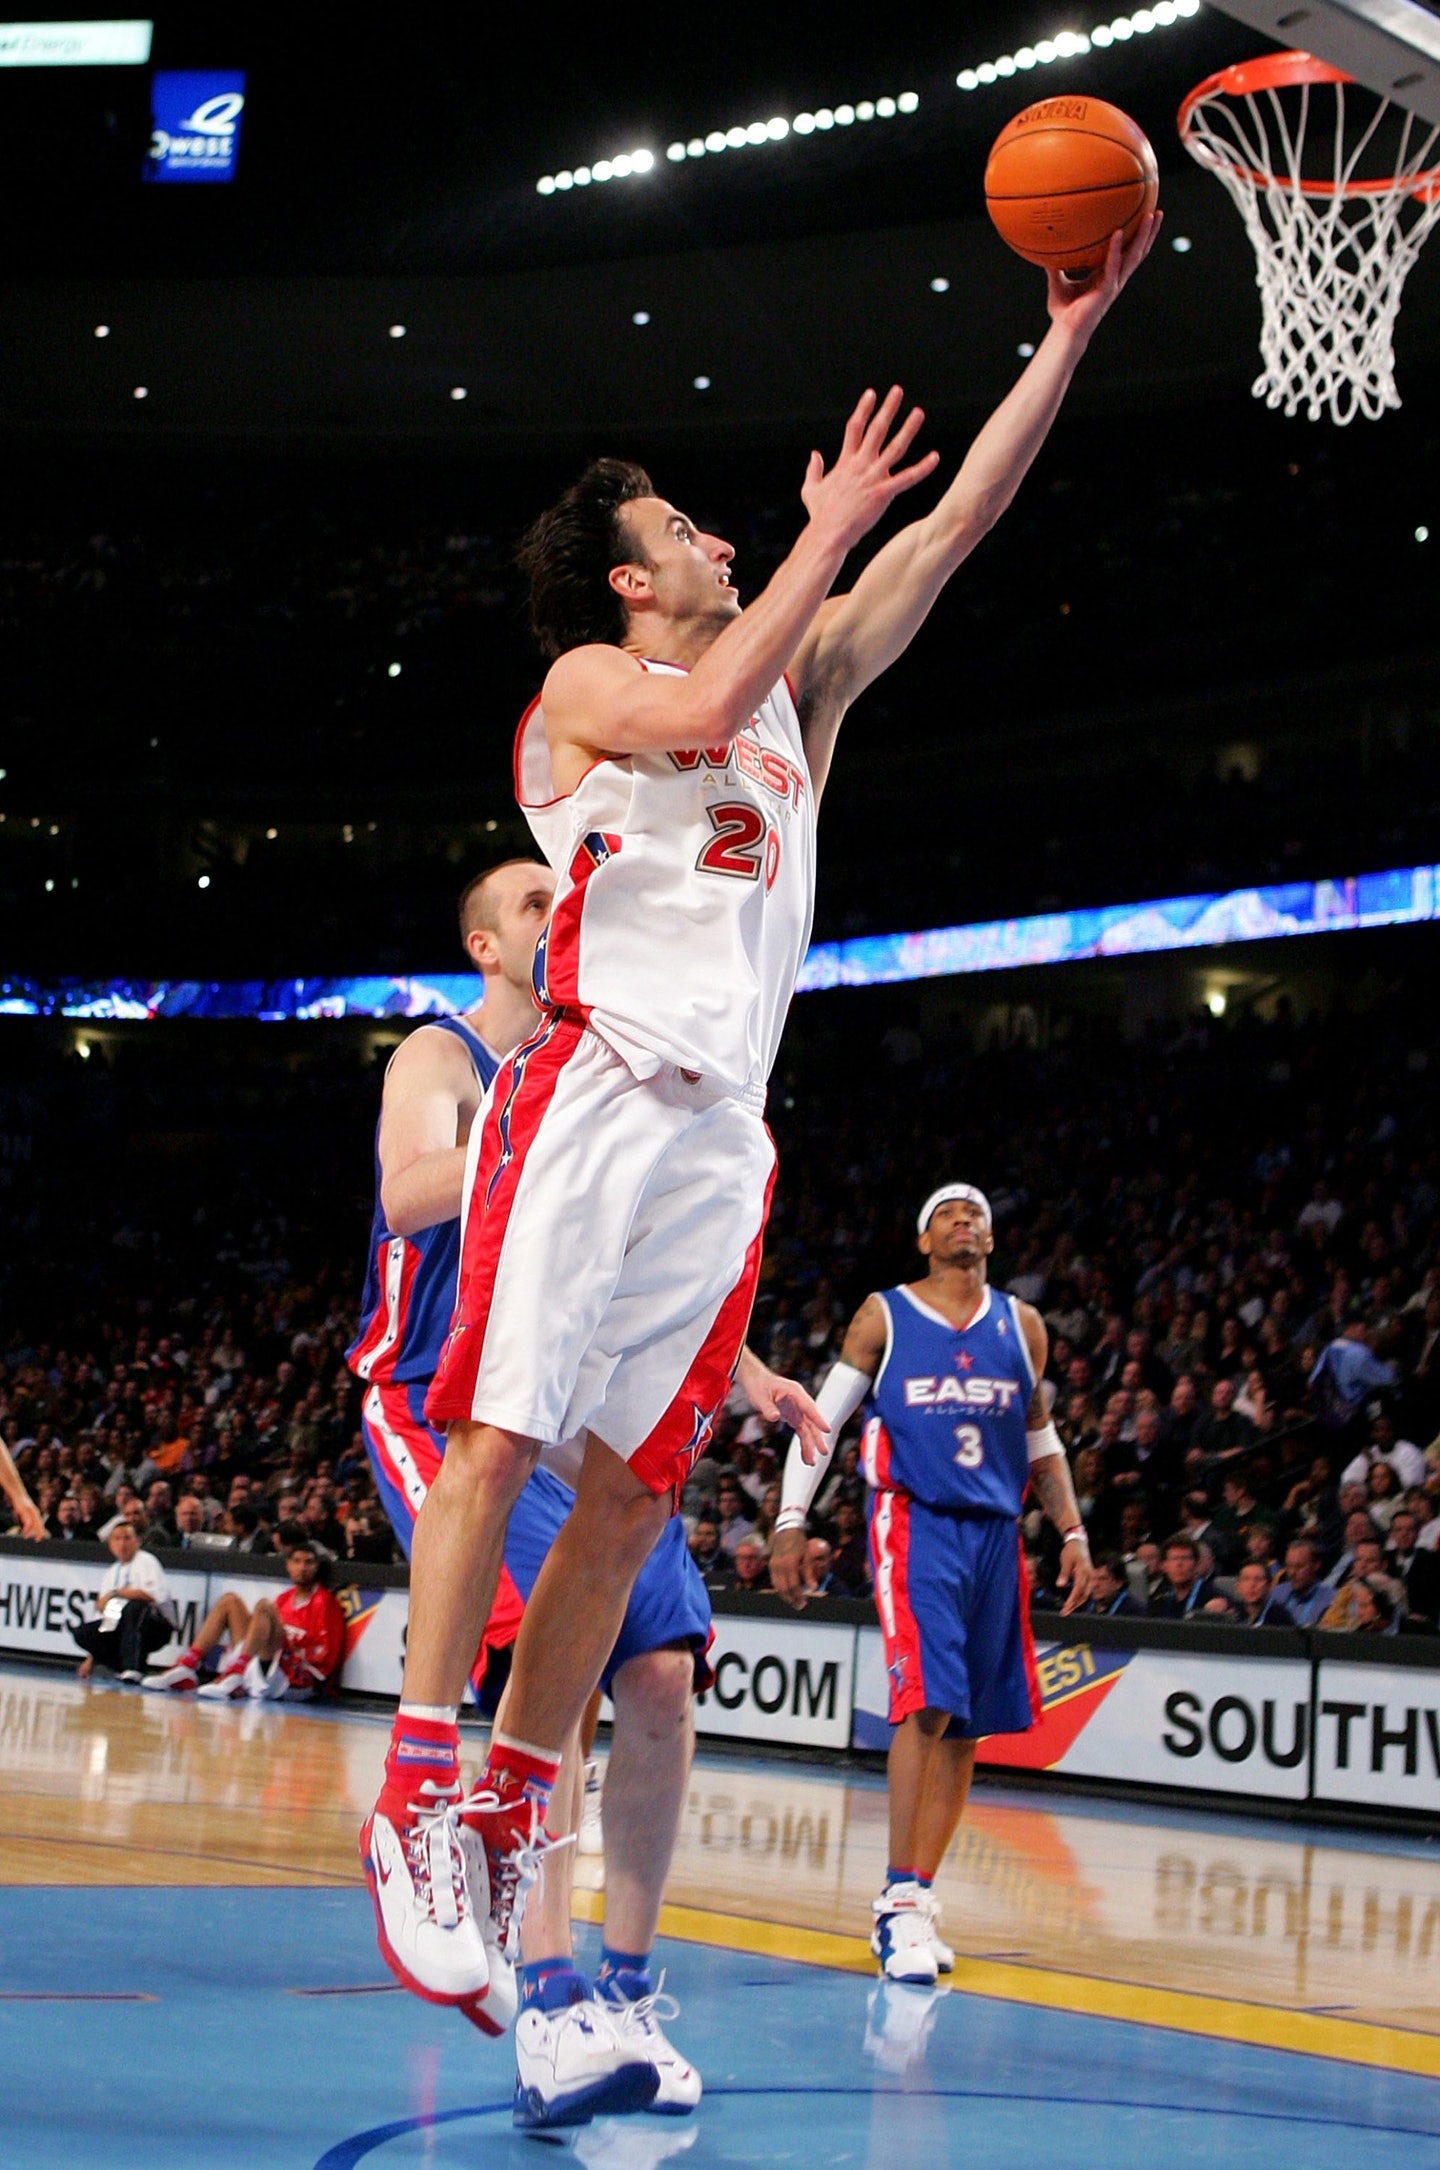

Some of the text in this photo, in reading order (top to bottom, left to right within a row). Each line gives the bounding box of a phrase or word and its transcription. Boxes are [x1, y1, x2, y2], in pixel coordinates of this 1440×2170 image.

[667, 734, 805, 814] WEST
[695, 801, 781, 898] 20
[904, 1374, 1020, 1409] EAST
[953, 1423, 984, 1470] 3
